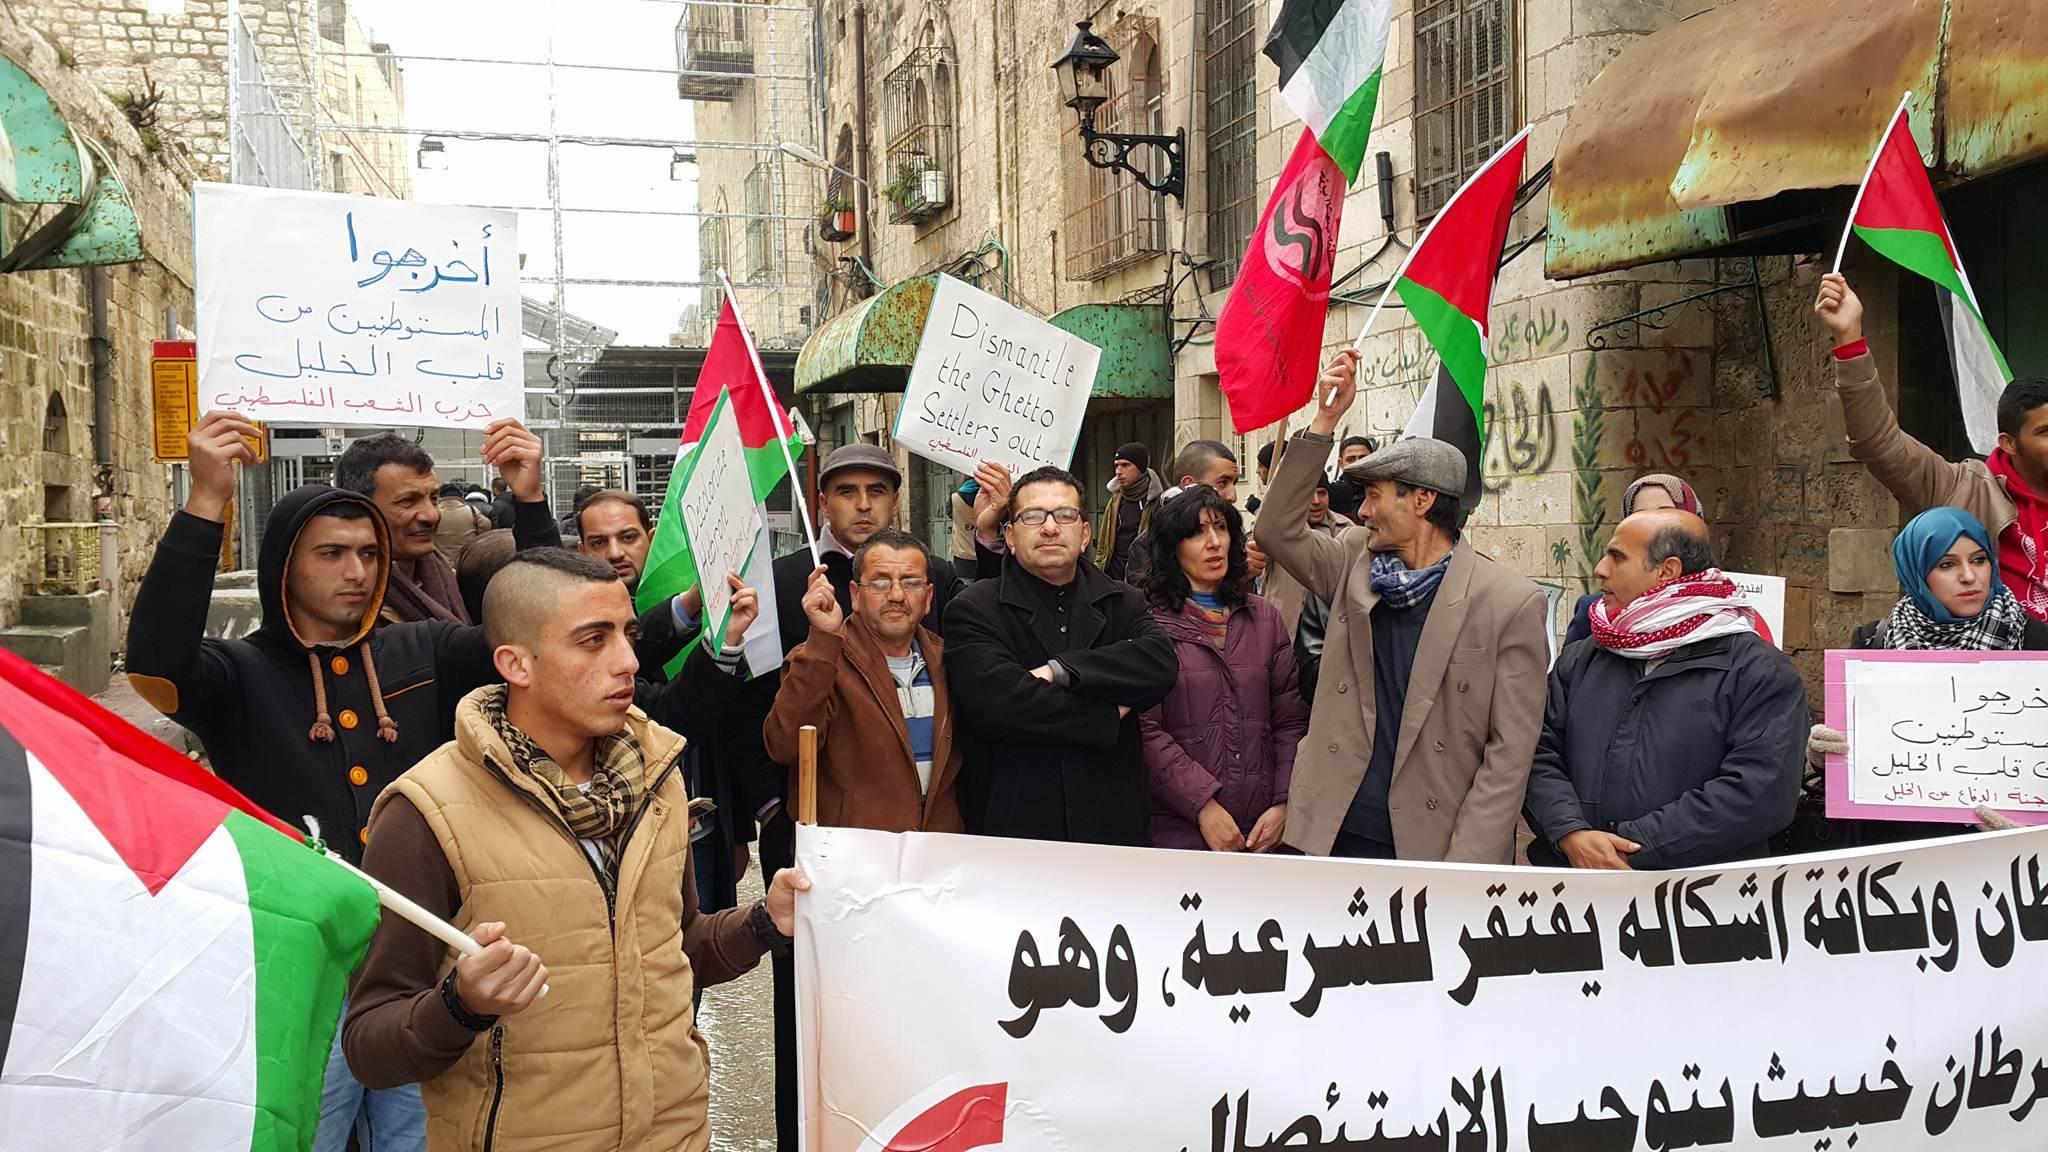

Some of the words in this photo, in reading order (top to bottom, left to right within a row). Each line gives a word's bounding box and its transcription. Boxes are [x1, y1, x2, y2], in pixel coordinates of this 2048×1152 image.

[347, 212, 492, 293] أخرجوا
[256, 296, 313, 323] من
[328, 302, 499, 340] المستوطنين
[235, 338, 391, 379] الخليل
[951, 303, 1075, 388] Dismantle
[416, 354, 504, 385] قلب
[937, 352, 971, 392] the
[981, 370, 1054, 428] Ghetto
[214, 386, 335, 412] الفلسطيني
[344, 391, 422, 413] الشعب
[434, 400, 493, 422] حزب
[919, 391, 1000, 443] Settlers
[699, 504, 729, 586] Hebron
[1891, 717, 2048, 751] ستوطنين
[1871, 751, 1942, 777] الخليل
[1953, 755, 2022, 781] قلب
[1928, 791, 1950, 801] عن
[1619, 865, 1789, 967] أشكاله
[1804, 862, 1960, 973] وبكافة
[1448, 882, 1604, 1006] يفتقر
[998, 917, 1139, 1039] وهو
[1753, 1035, 1914, 1152] خبيث
